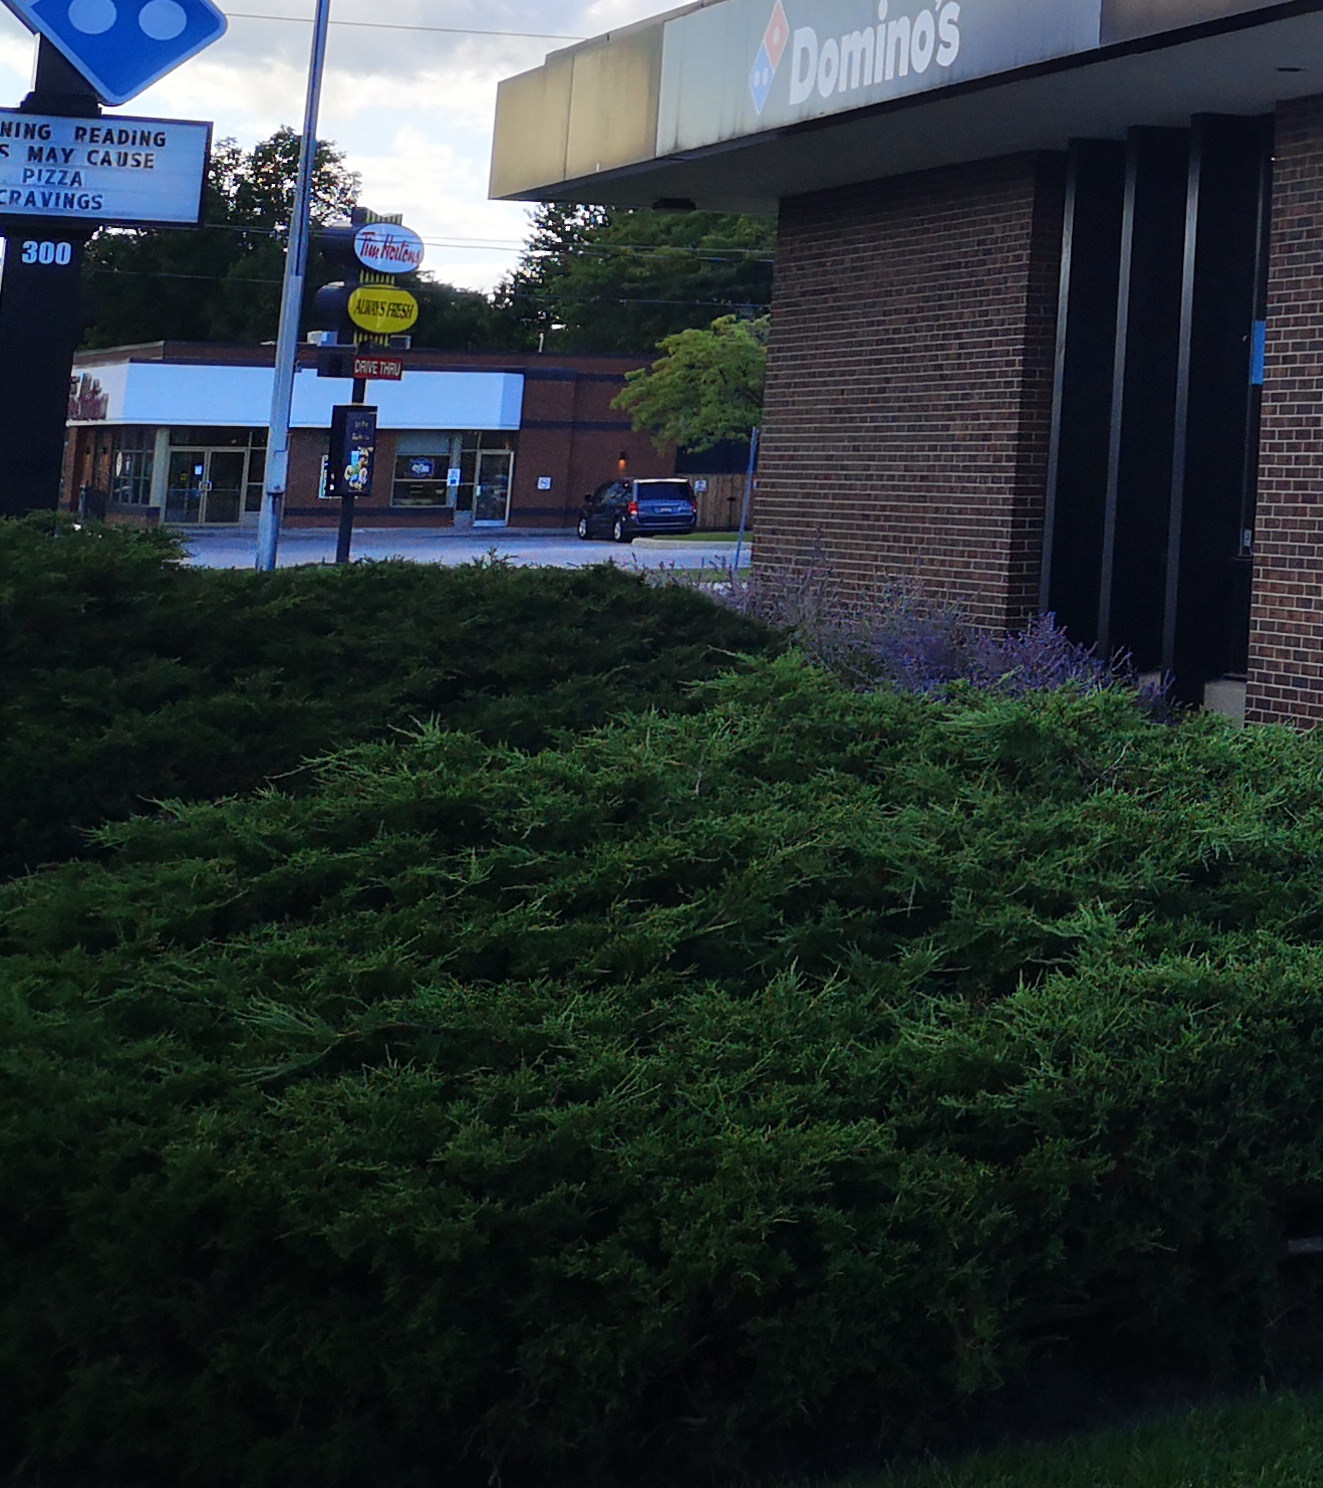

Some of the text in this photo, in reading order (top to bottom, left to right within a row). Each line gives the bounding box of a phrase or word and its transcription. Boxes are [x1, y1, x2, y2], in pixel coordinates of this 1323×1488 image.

[74, 126, 166, 147] READING
[27, 145, 75, 164] MAY
[86, 149, 155, 169] CAUSE
[22, 167, 82, 187] PIZZA
[21, 240, 72, 265] 300
[359, 231, 422, 266] Tim Hortons
[354, 298, 415, 320] ALWAYS FRESH
[354, 359, 401, 377] DRIVE THRU
